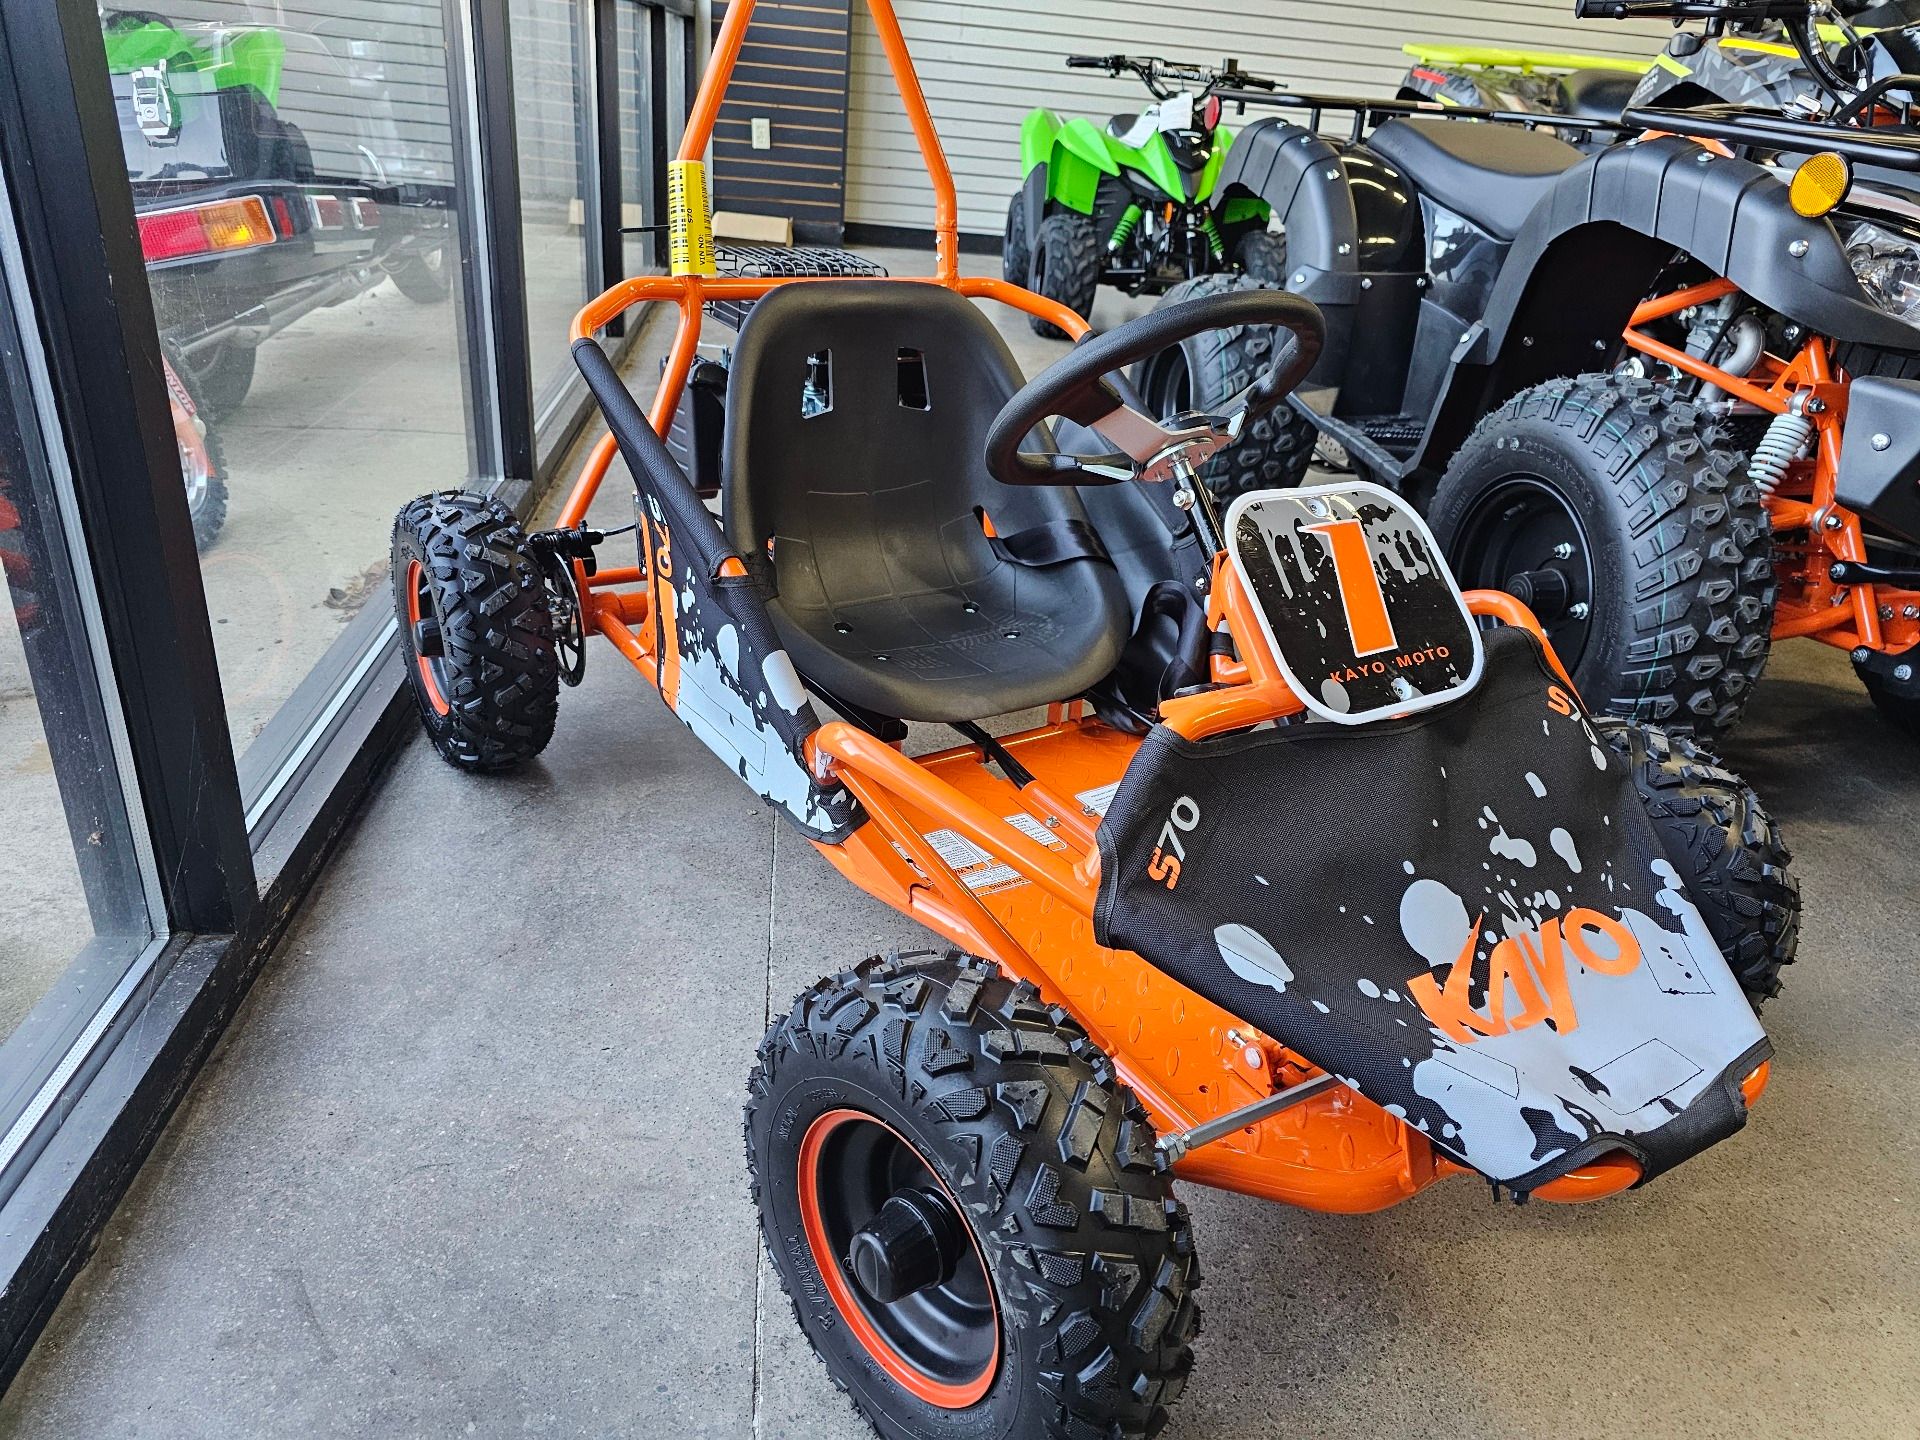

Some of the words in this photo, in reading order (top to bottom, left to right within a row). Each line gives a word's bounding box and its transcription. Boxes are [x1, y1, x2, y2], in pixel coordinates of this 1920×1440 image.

[647, 493, 672, 578] S70
[1296, 519, 1399, 659] 1
[1329, 661, 1386, 684] KAYO
[1395, 646, 1450, 668] MOTO
[989, 876, 1024, 891] WARNING
[1147, 795, 1200, 890] S70
[1406, 907, 1642, 1044] KAYO
